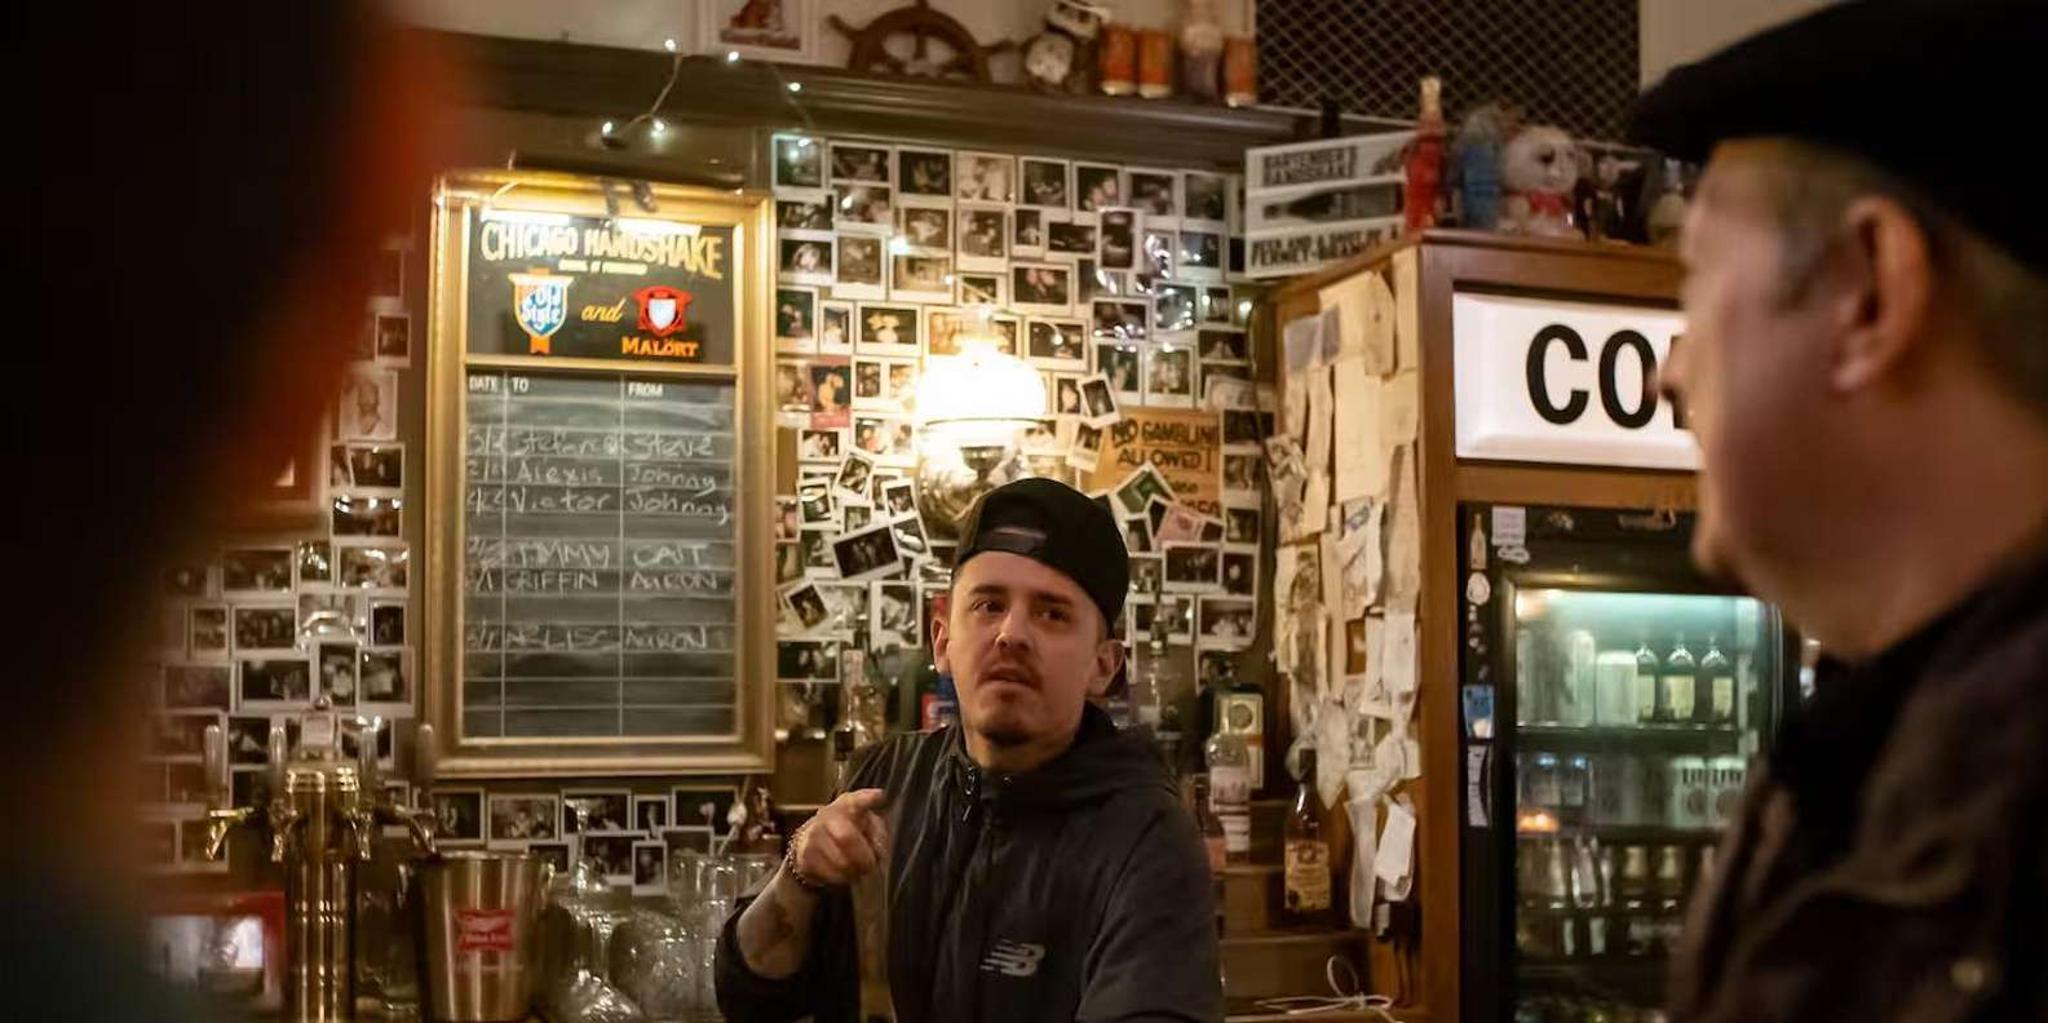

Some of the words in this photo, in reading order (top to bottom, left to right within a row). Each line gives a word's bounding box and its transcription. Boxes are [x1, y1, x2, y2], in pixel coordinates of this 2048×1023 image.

[480, 220, 577, 260] CHICAGO
[584, 227, 724, 279] HANDSHAKE
[581, 298, 627, 323] and
[468, 376, 499, 392] DATE
[512, 377, 529, 392] TO
[1526, 324, 1686, 430] CO
[628, 381, 663, 397] FROM
